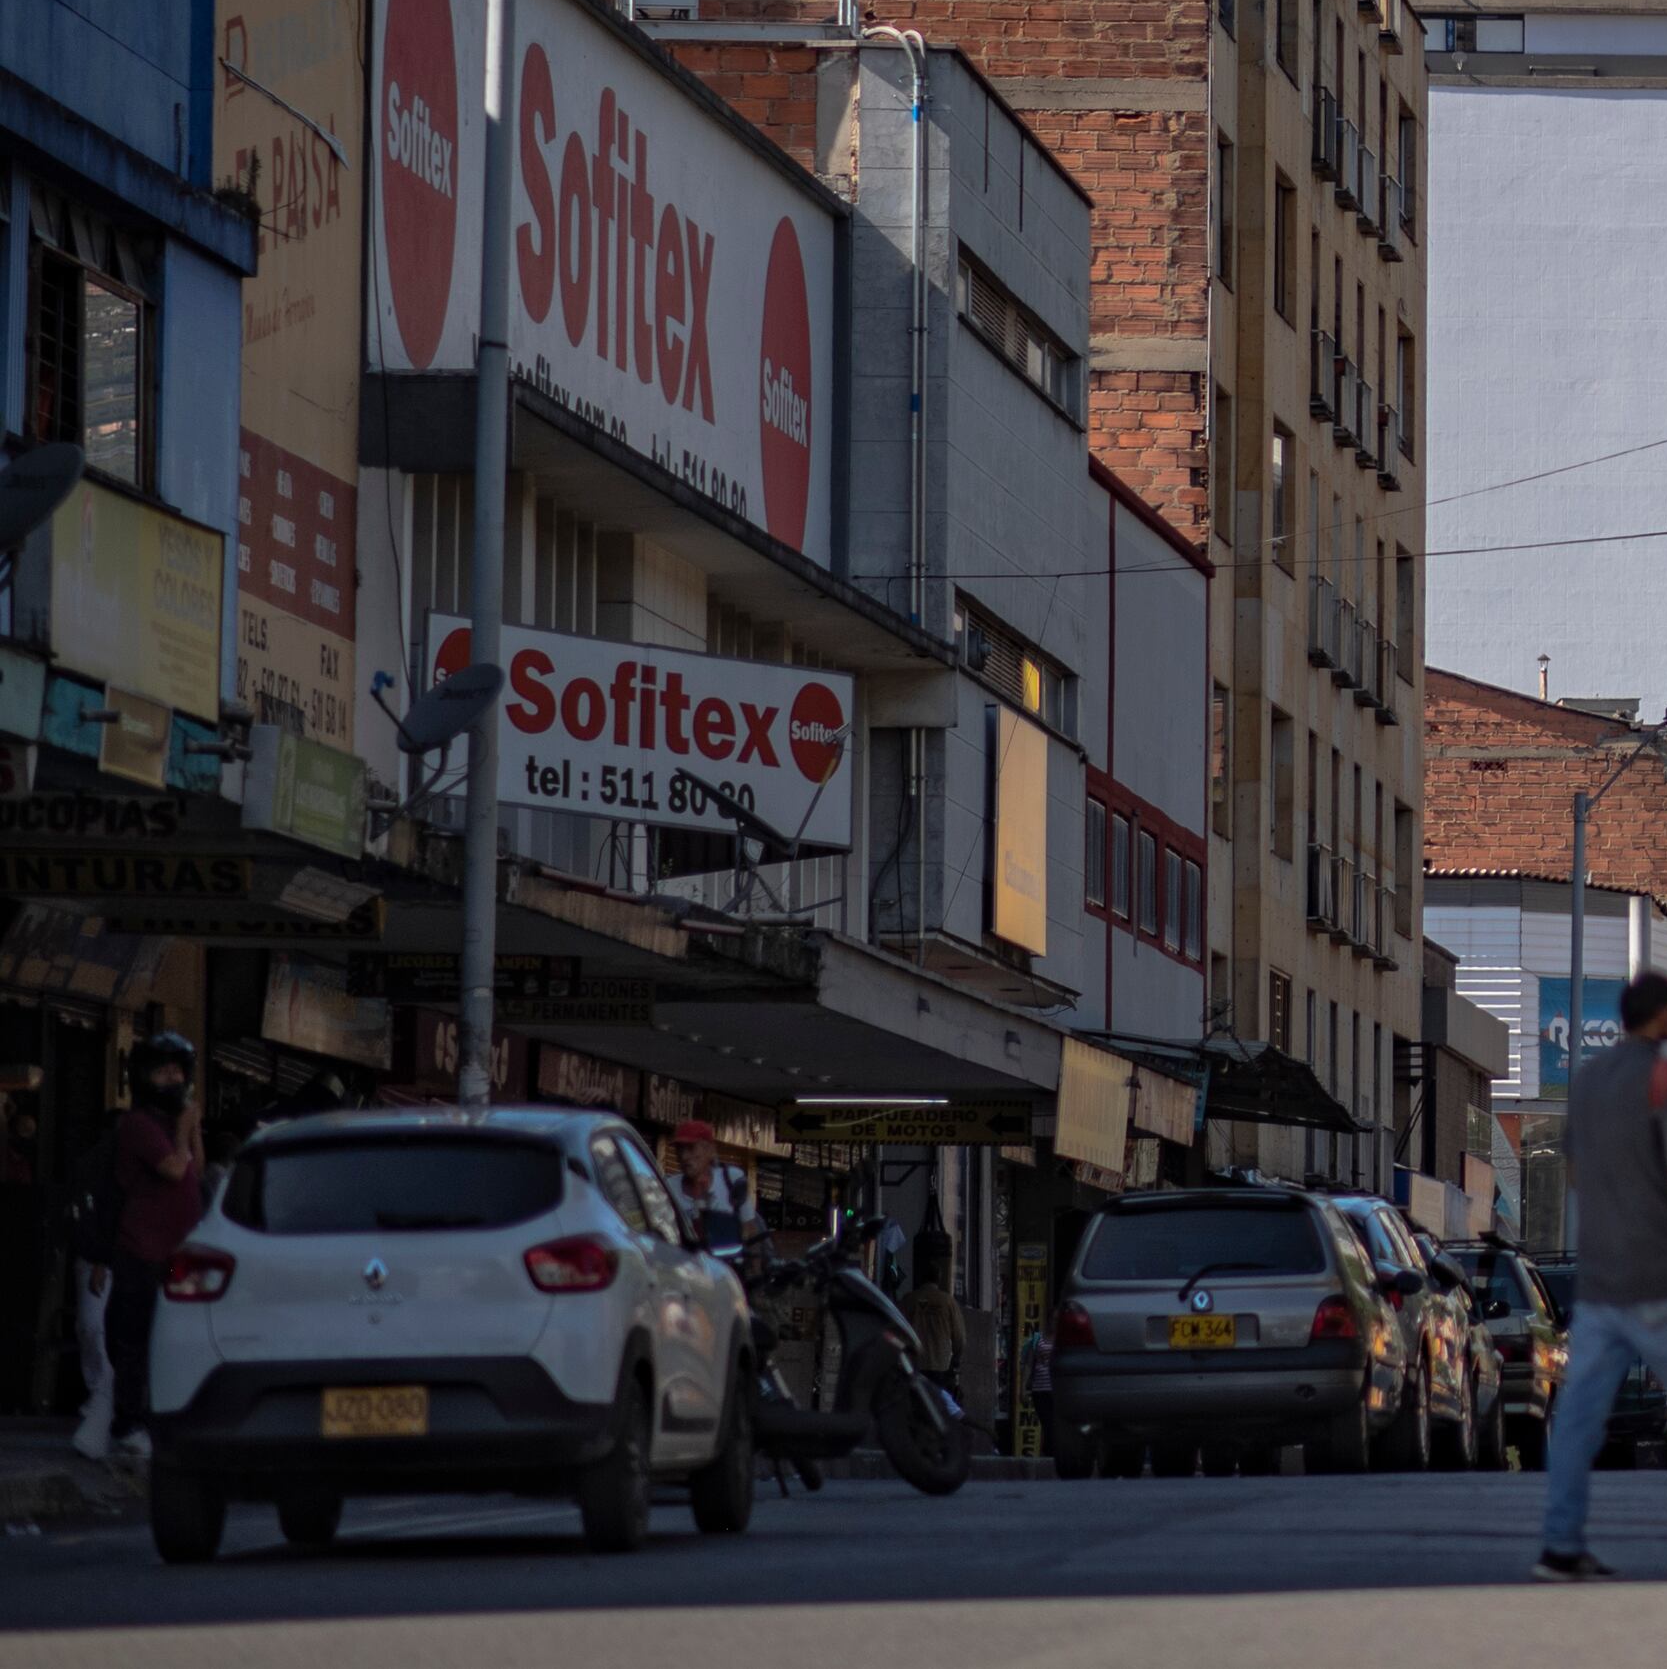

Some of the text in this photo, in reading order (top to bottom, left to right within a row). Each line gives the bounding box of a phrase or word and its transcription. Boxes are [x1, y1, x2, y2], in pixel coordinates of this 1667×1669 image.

[388, 80, 453, 198] Sofitex
[516, 42, 715, 425] Sofitex
[761, 357, 808, 448] Sofitex
[320, 643, 340, 683] FAX
[506, 648, 780, 769] Sofitex
[526, 756, 570, 798] tel
[600, 766, 658, 811] 511
[531, 1002, 649, 1022] PERMANENTES
[830, 1108, 978, 1123] PARQUEADERO
[852, 1124, 956, 1138] DE MOTOS
